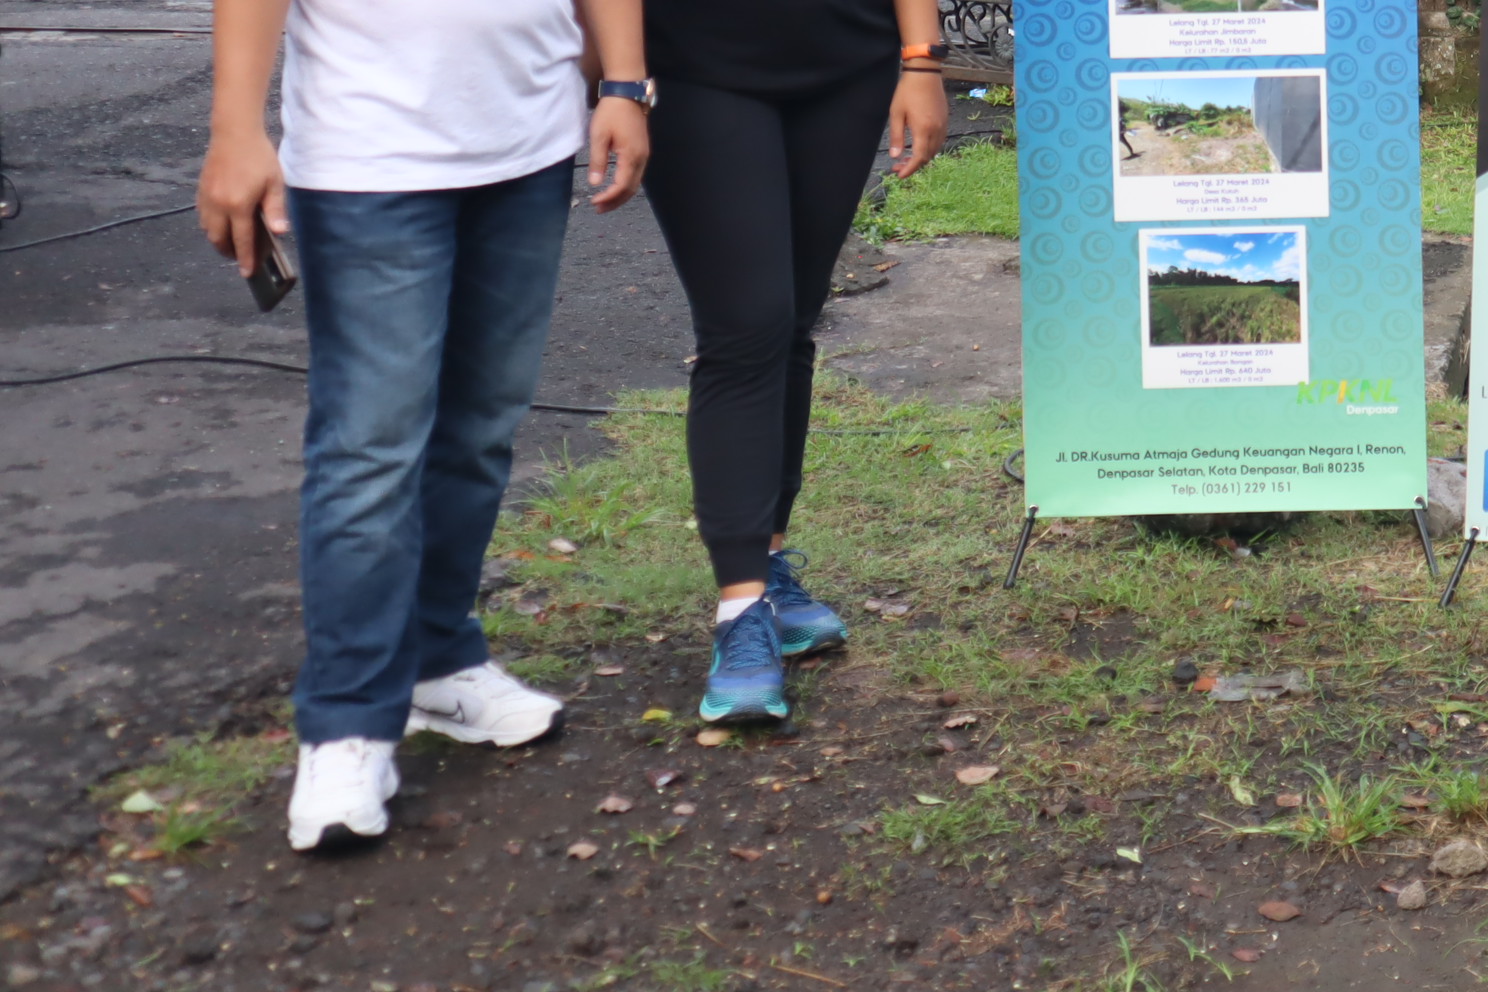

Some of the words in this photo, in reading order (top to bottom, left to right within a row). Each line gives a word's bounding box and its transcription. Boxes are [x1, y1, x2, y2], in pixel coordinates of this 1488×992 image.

[1296, 378, 1399, 404] KPKNL
[1346, 405, 1399, 415] Denpasar
[1056, 452, 1067, 463] Jl.
[1144, 448, 1188, 462] Atmaja
[1191, 447, 1240, 460] Gedung
[1243, 446, 1306, 459] Keuangan
[1309, 445, 1354, 457] Negara
[1366, 443, 1406, 456] Renon,
[1098, 467, 1154, 480] Denpasar
[1158, 466, 1205, 479] Selatan,
[1208, 465, 1237, 476] Kota
[1240, 464, 1299, 477] Denpasar,
[1303, 462, 1324, 474] Bali
[1328, 462, 1365, 474] 80235
[1171, 483, 1198, 497] Telp.
[1201, 481, 1241, 495] (0361)
[1245, 481, 1265, 493] 229
[1272, 481, 1292, 493] 151
